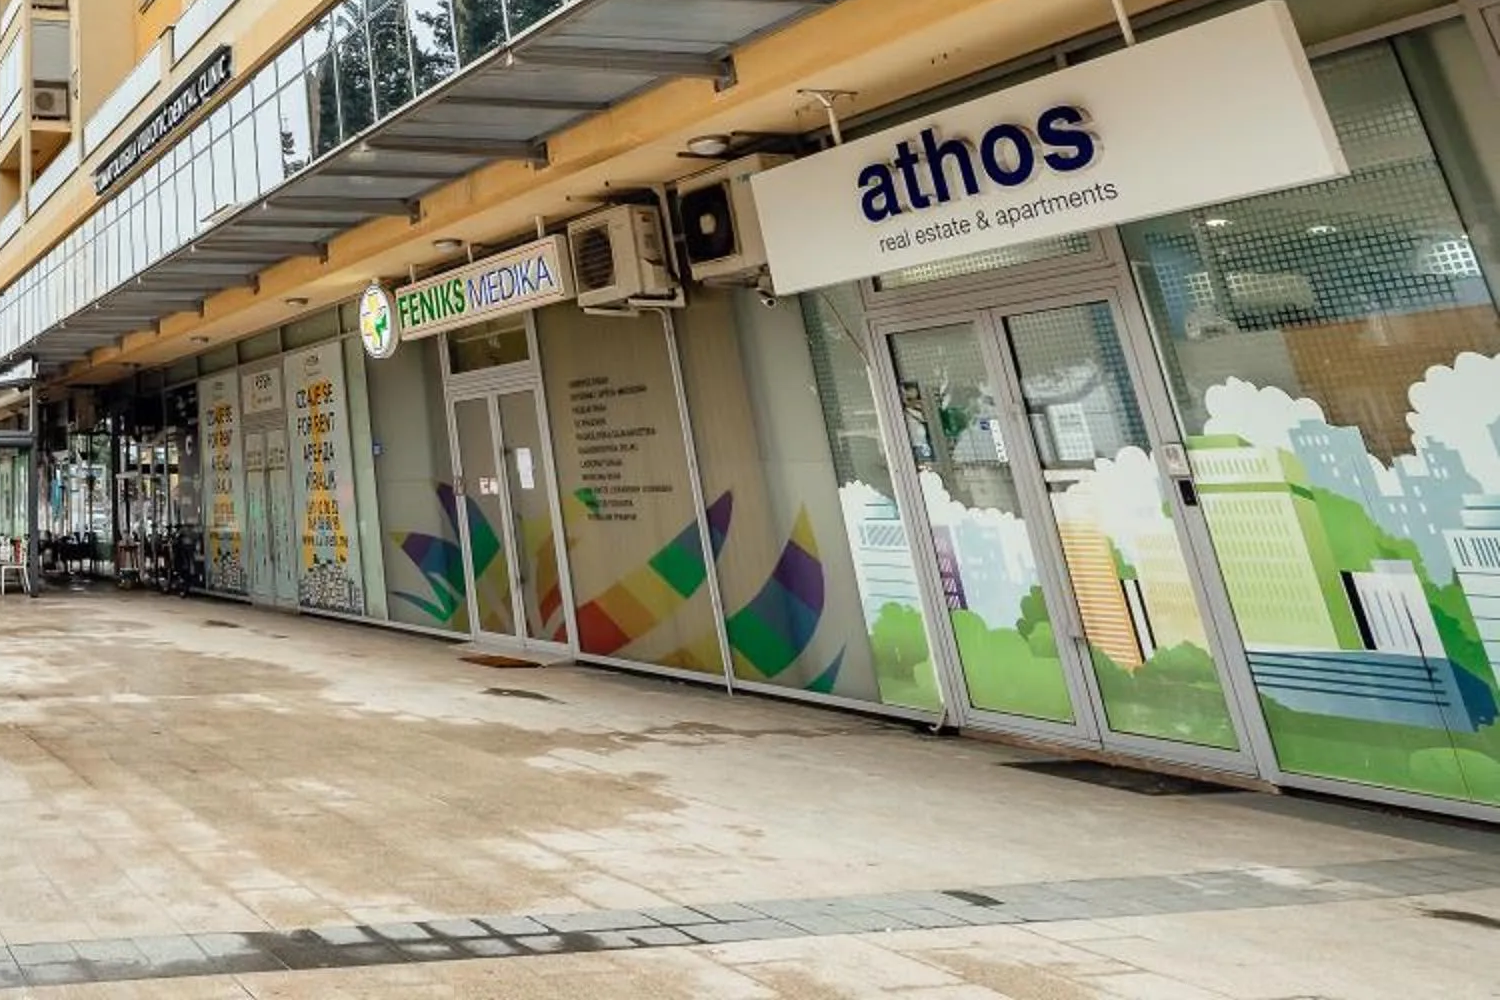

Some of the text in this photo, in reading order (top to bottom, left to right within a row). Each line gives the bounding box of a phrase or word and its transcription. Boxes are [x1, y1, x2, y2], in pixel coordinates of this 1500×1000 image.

[858, 105, 1095, 223] athos
[879, 182, 1119, 253] real estate & apartments
[396, 256, 555, 329] FENIKS MEDIKA
